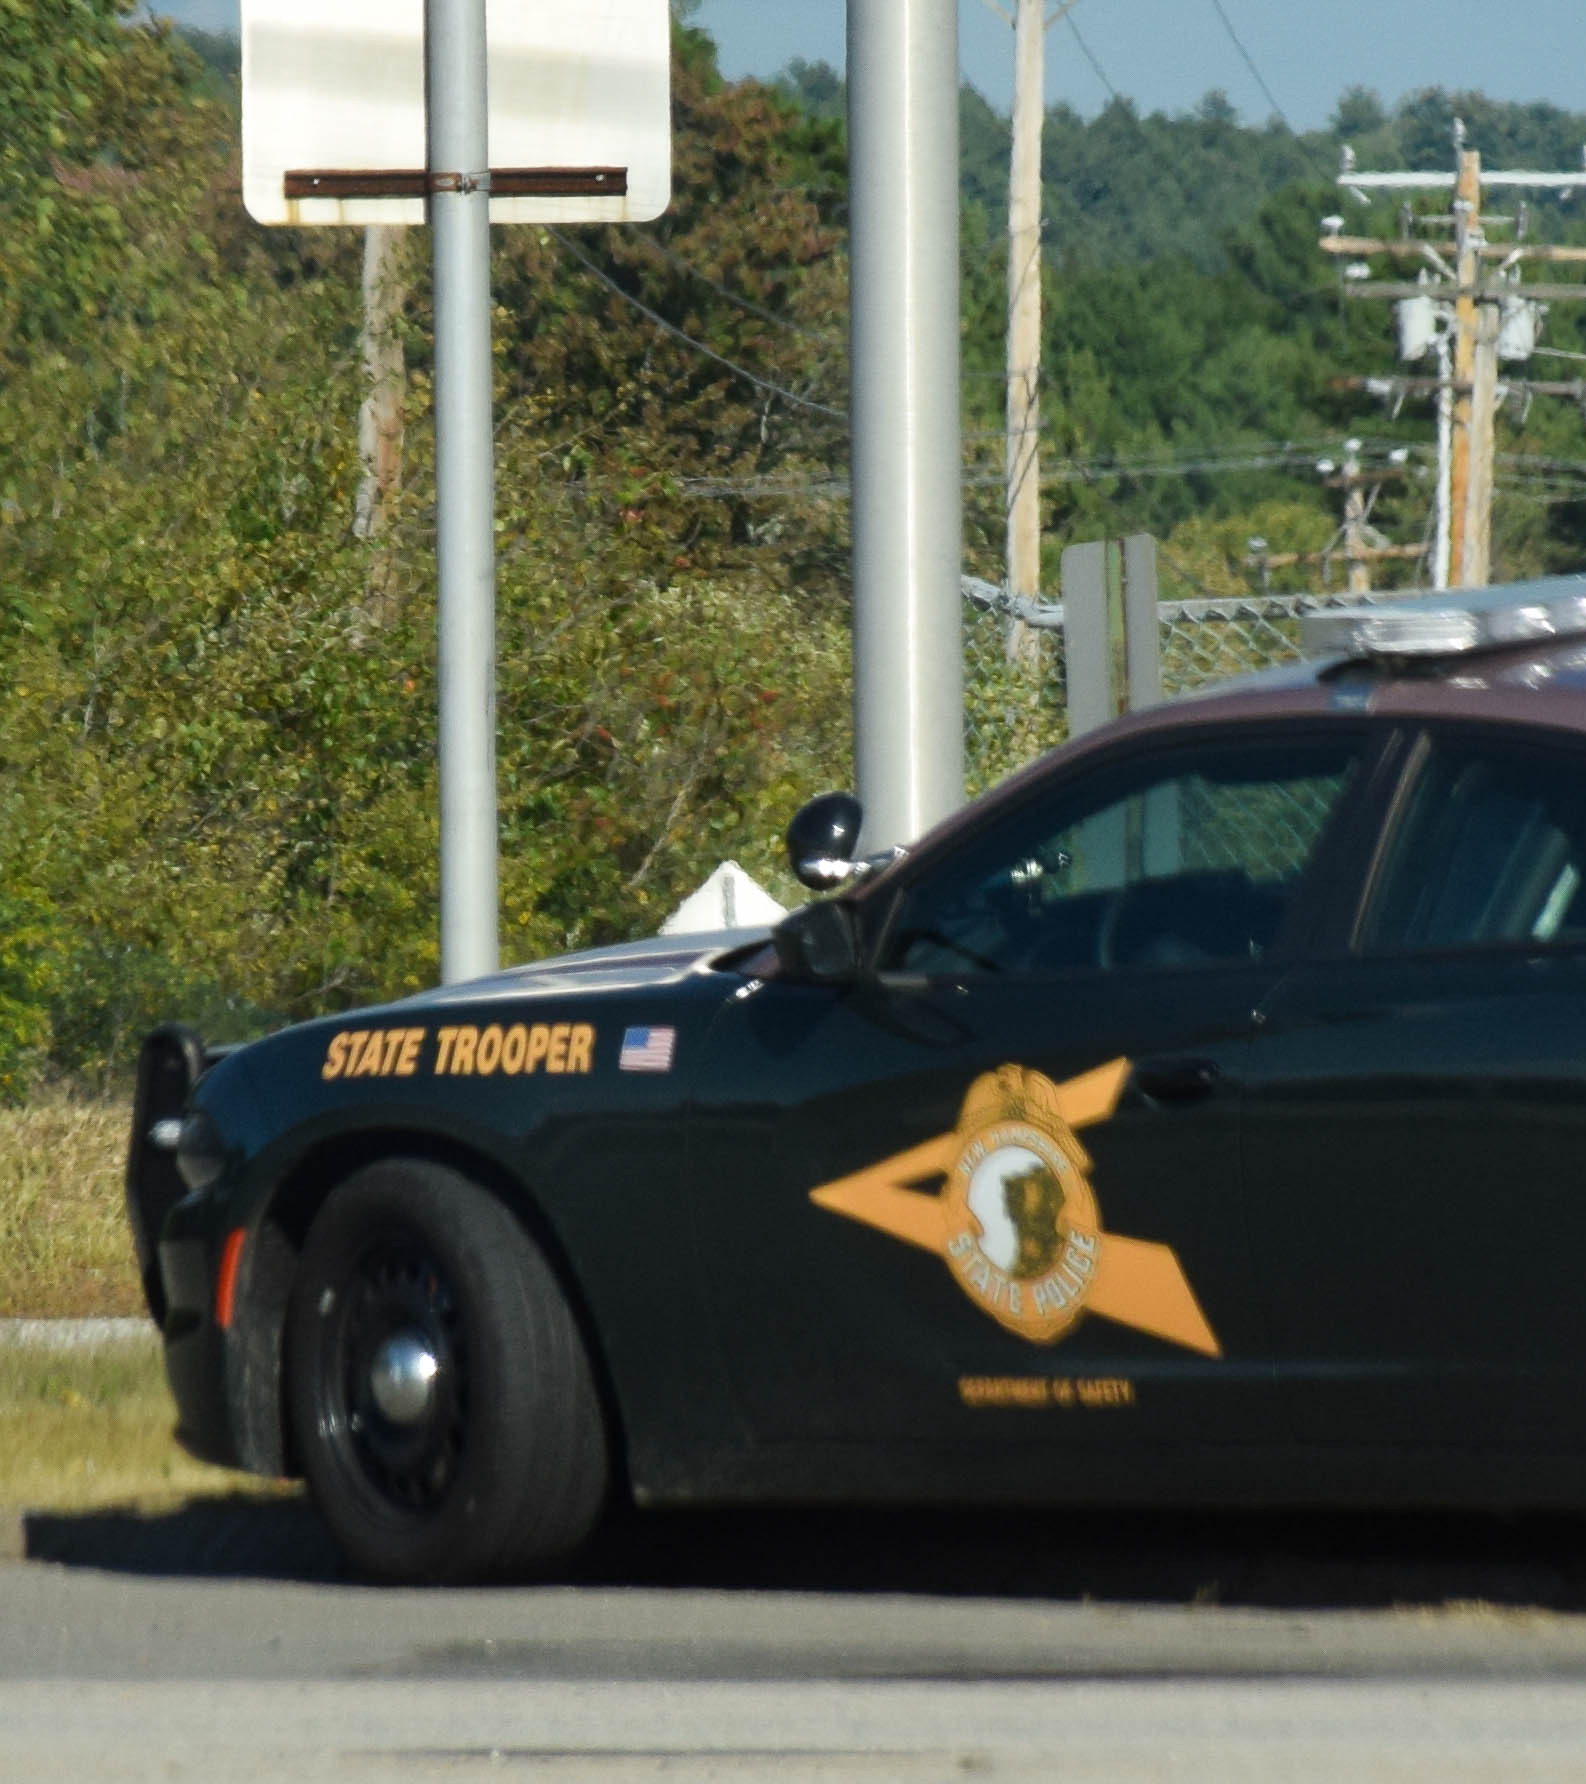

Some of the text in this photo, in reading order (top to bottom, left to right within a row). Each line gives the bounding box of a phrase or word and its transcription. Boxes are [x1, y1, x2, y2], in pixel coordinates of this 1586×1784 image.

[322, 1023, 595, 1080] STATE TROOPER
[948, 1229, 1096, 1316] STATE POLICE
